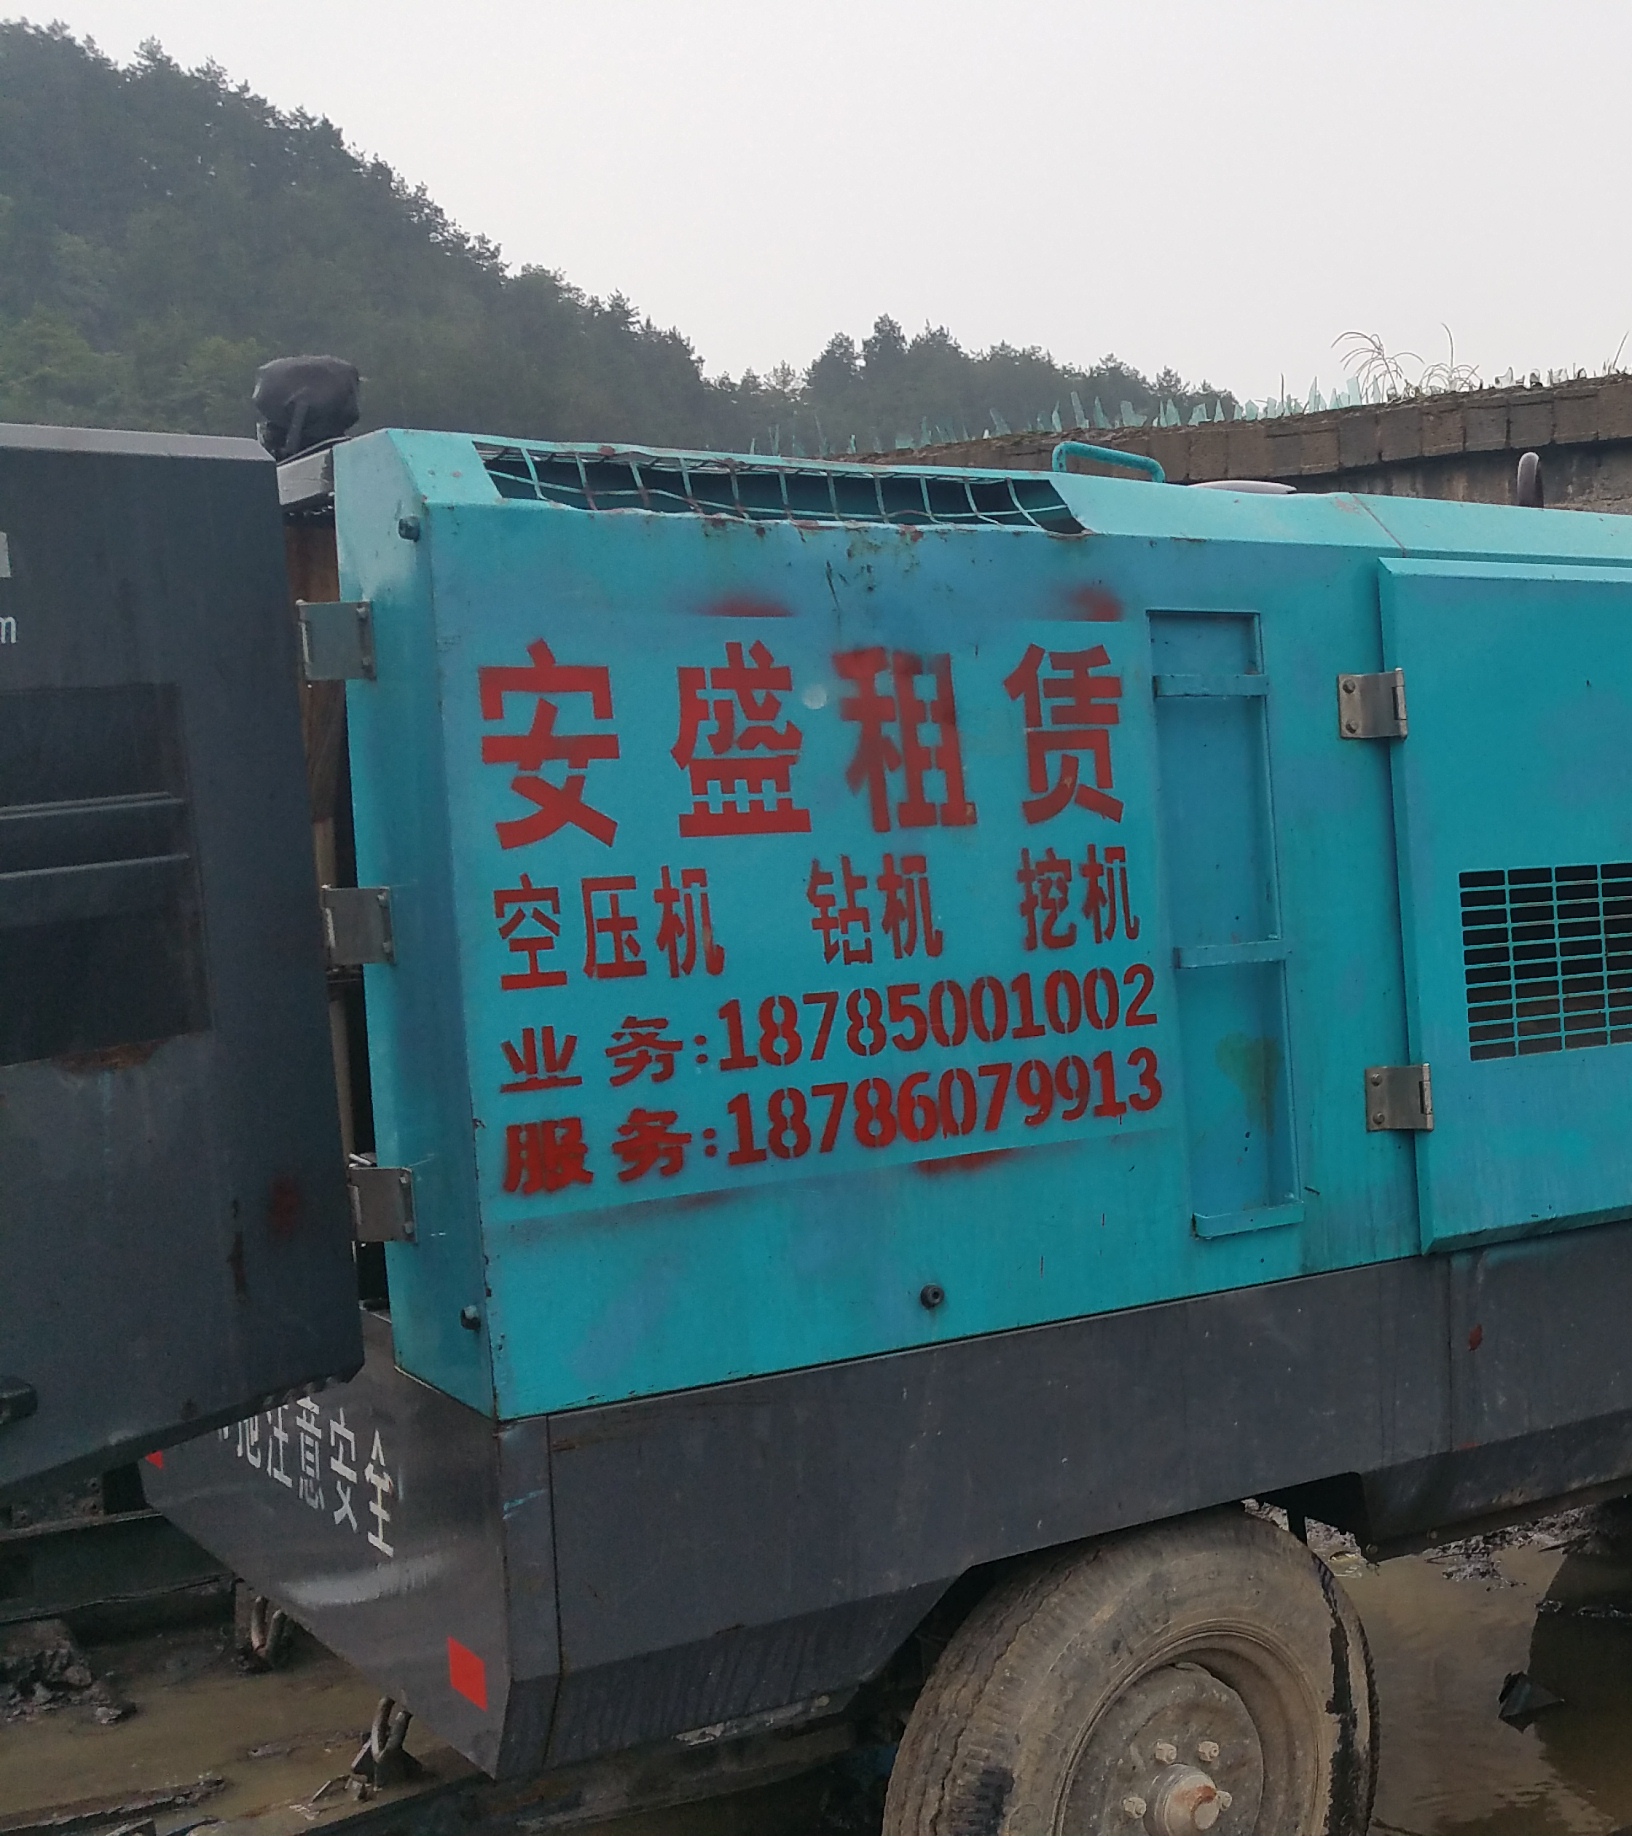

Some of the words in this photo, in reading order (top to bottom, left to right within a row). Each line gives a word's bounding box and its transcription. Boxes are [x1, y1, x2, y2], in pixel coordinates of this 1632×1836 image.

[478, 638, 1124, 850] 安盛租赁
[493, 865, 726, 991] 空压机
[806, 852, 944, 966] 钻机
[1016, 843, 1140, 951] 挖机
